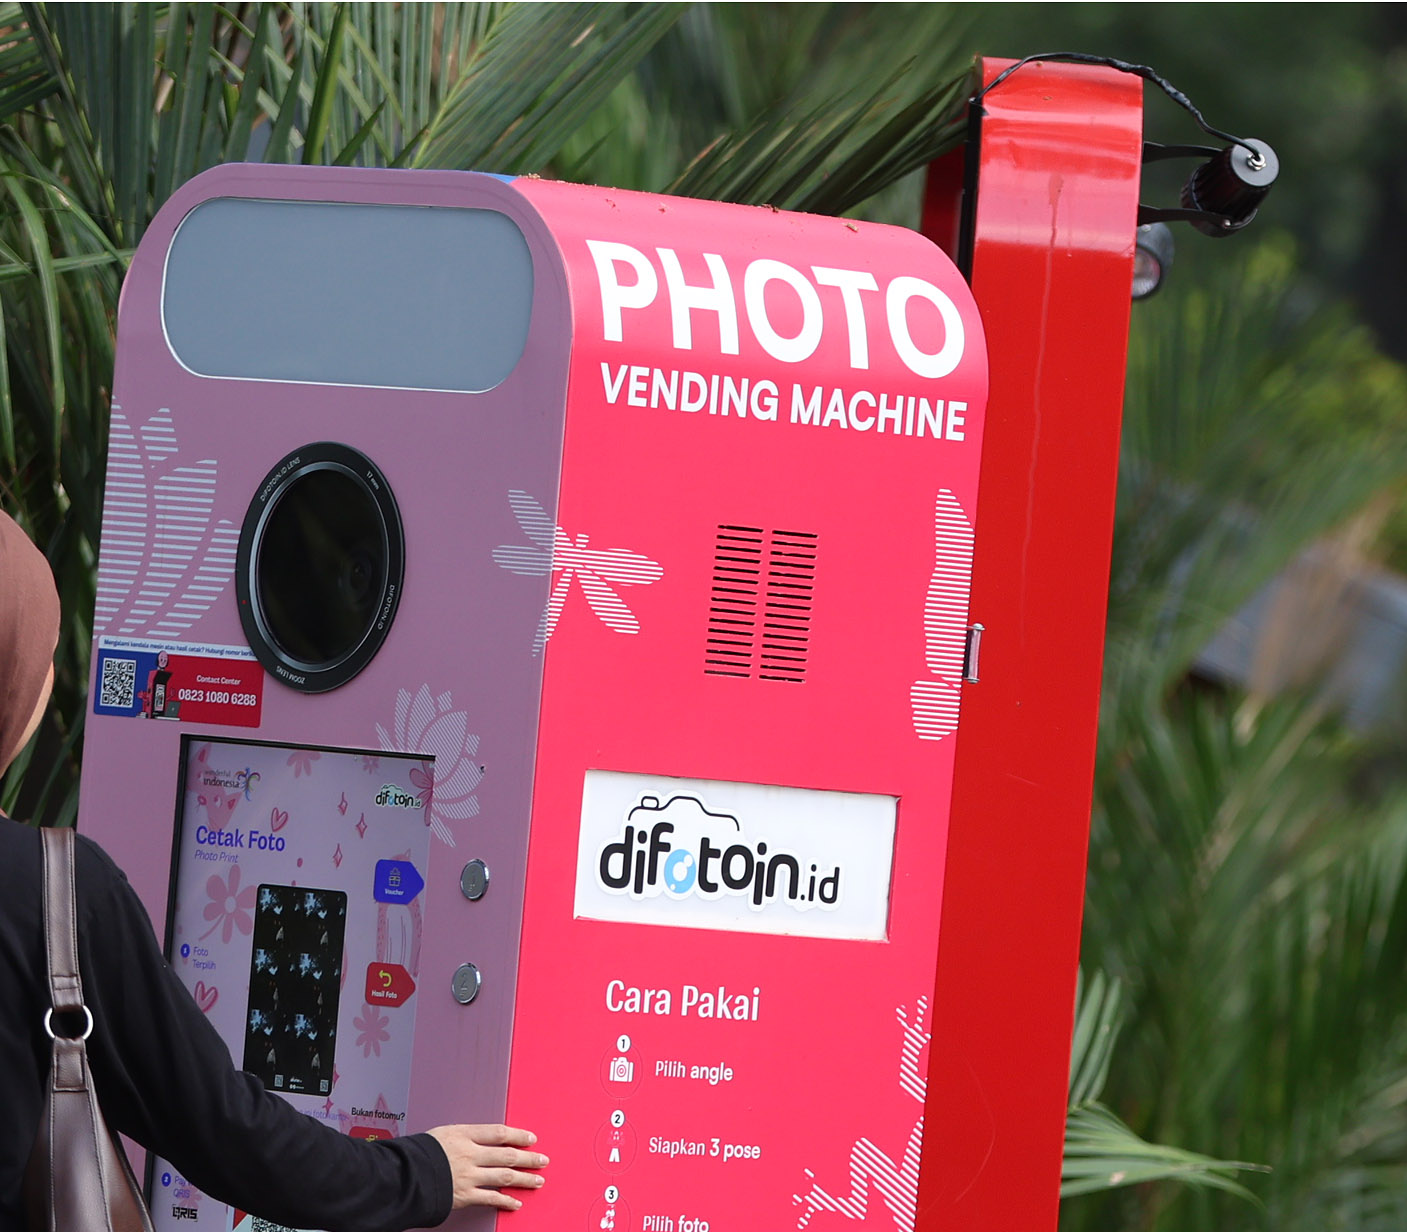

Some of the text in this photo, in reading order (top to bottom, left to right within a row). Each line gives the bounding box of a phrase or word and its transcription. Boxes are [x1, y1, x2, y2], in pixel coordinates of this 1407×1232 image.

[585, 239, 965, 379] PHOTO
[600, 362, 968, 442] VENDING MACHINE
[196, 674, 241, 685] Contact Center
[178, 688, 256, 706] 0823 1080 6288
[375, 790, 421, 808] difotoin.id
[196, 825, 285, 852] Cetak Foto
[194, 849, 239, 864] Photo Print
[599, 822, 840, 905] difotoin.id
[384, 888, 404, 896] Voucher
[193, 946, 209, 957] Foto
[371, 990, 398, 999] Hasil Foto
[605, 979, 760, 1021] Cara Pakai
[621, 1038, 626, 1049] 1
[655, 1060, 734, 1086] Pilih angle
[351, 1107, 406, 1121] Bukan fotomu?
[614, 1114, 621, 1124] 2
[648, 1136, 761, 1162] Siapkan 3 pose
[173, 1188, 191, 1199] QRIS
[608, 1189, 615, 1200] 3
[642, 1215, 674, 1232] Pilih
